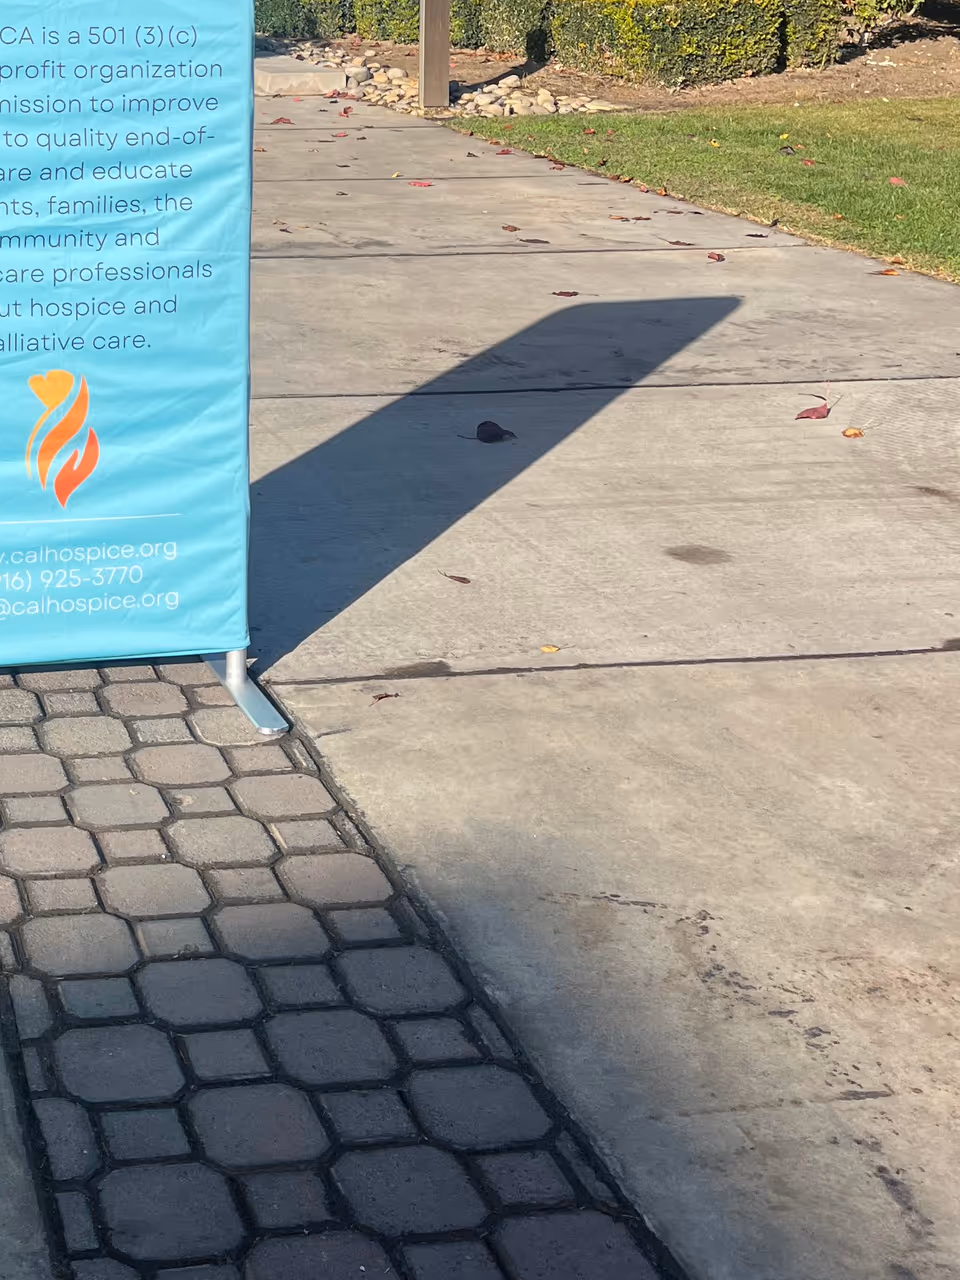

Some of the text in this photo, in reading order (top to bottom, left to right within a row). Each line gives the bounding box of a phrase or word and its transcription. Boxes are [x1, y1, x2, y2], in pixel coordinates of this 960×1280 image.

[42, 26, 59, 45] is
[68, 29, 81, 45] a
[88, 27, 126, 45] 501
[74, 60, 223, 84] organization
[89, 96, 114, 113] to
[122, 94, 219, 116] improve
[3, 131, 28, 148] to
[36, 128, 116, 151] quality
[125, 126, 215, 146] end-of-
[40, 163, 84, 181] and
[93, 162, 193, 181] educate
[47, 195, 146, 216] families,
[154, 193, 193, 211] the
[115, 228, 159, 247] and
[53, 261, 213, 286] professionals
[30, 298, 126, 320] hospice
[134, 296, 177, 314] and
[92, 333, 151, 350] care.
[40, 566, 143, 589] 925-3770
